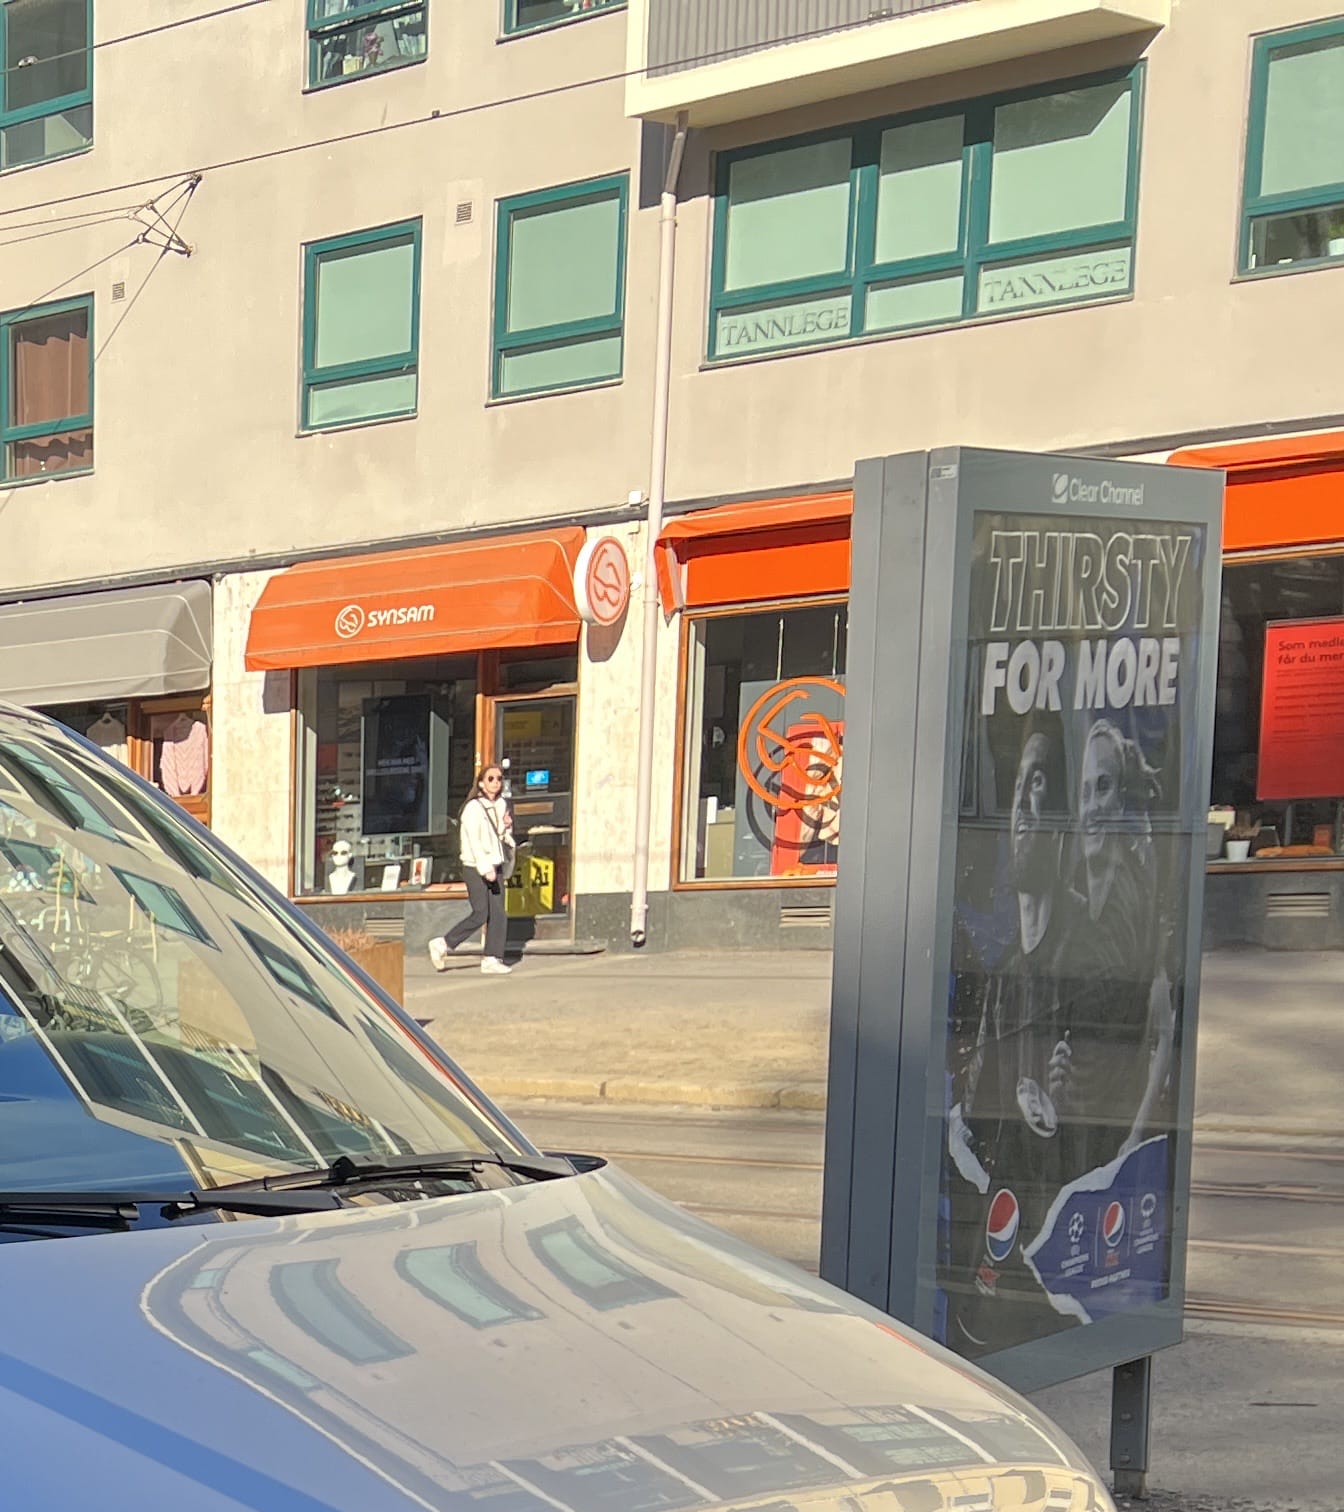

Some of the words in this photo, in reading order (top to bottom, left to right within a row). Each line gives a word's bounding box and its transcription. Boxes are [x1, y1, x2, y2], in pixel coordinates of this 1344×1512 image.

[722, 306, 849, 347] TANNLEGE
[1070, 481, 1099, 502] Clear
[1101, 481, 1144, 505] Channel
[990, 530, 1192, 632] THIRSTY
[367, 604, 435, 628] SYNSAM
[1278, 640, 1305, 651] Som
[1278, 653, 1297, 665] får
[1300, 653, 1316, 663] du
[981, 640, 1065, 716] FOR
[1073, 637, 1180, 711] MORE
[531, 862, 549, 888] Ai
